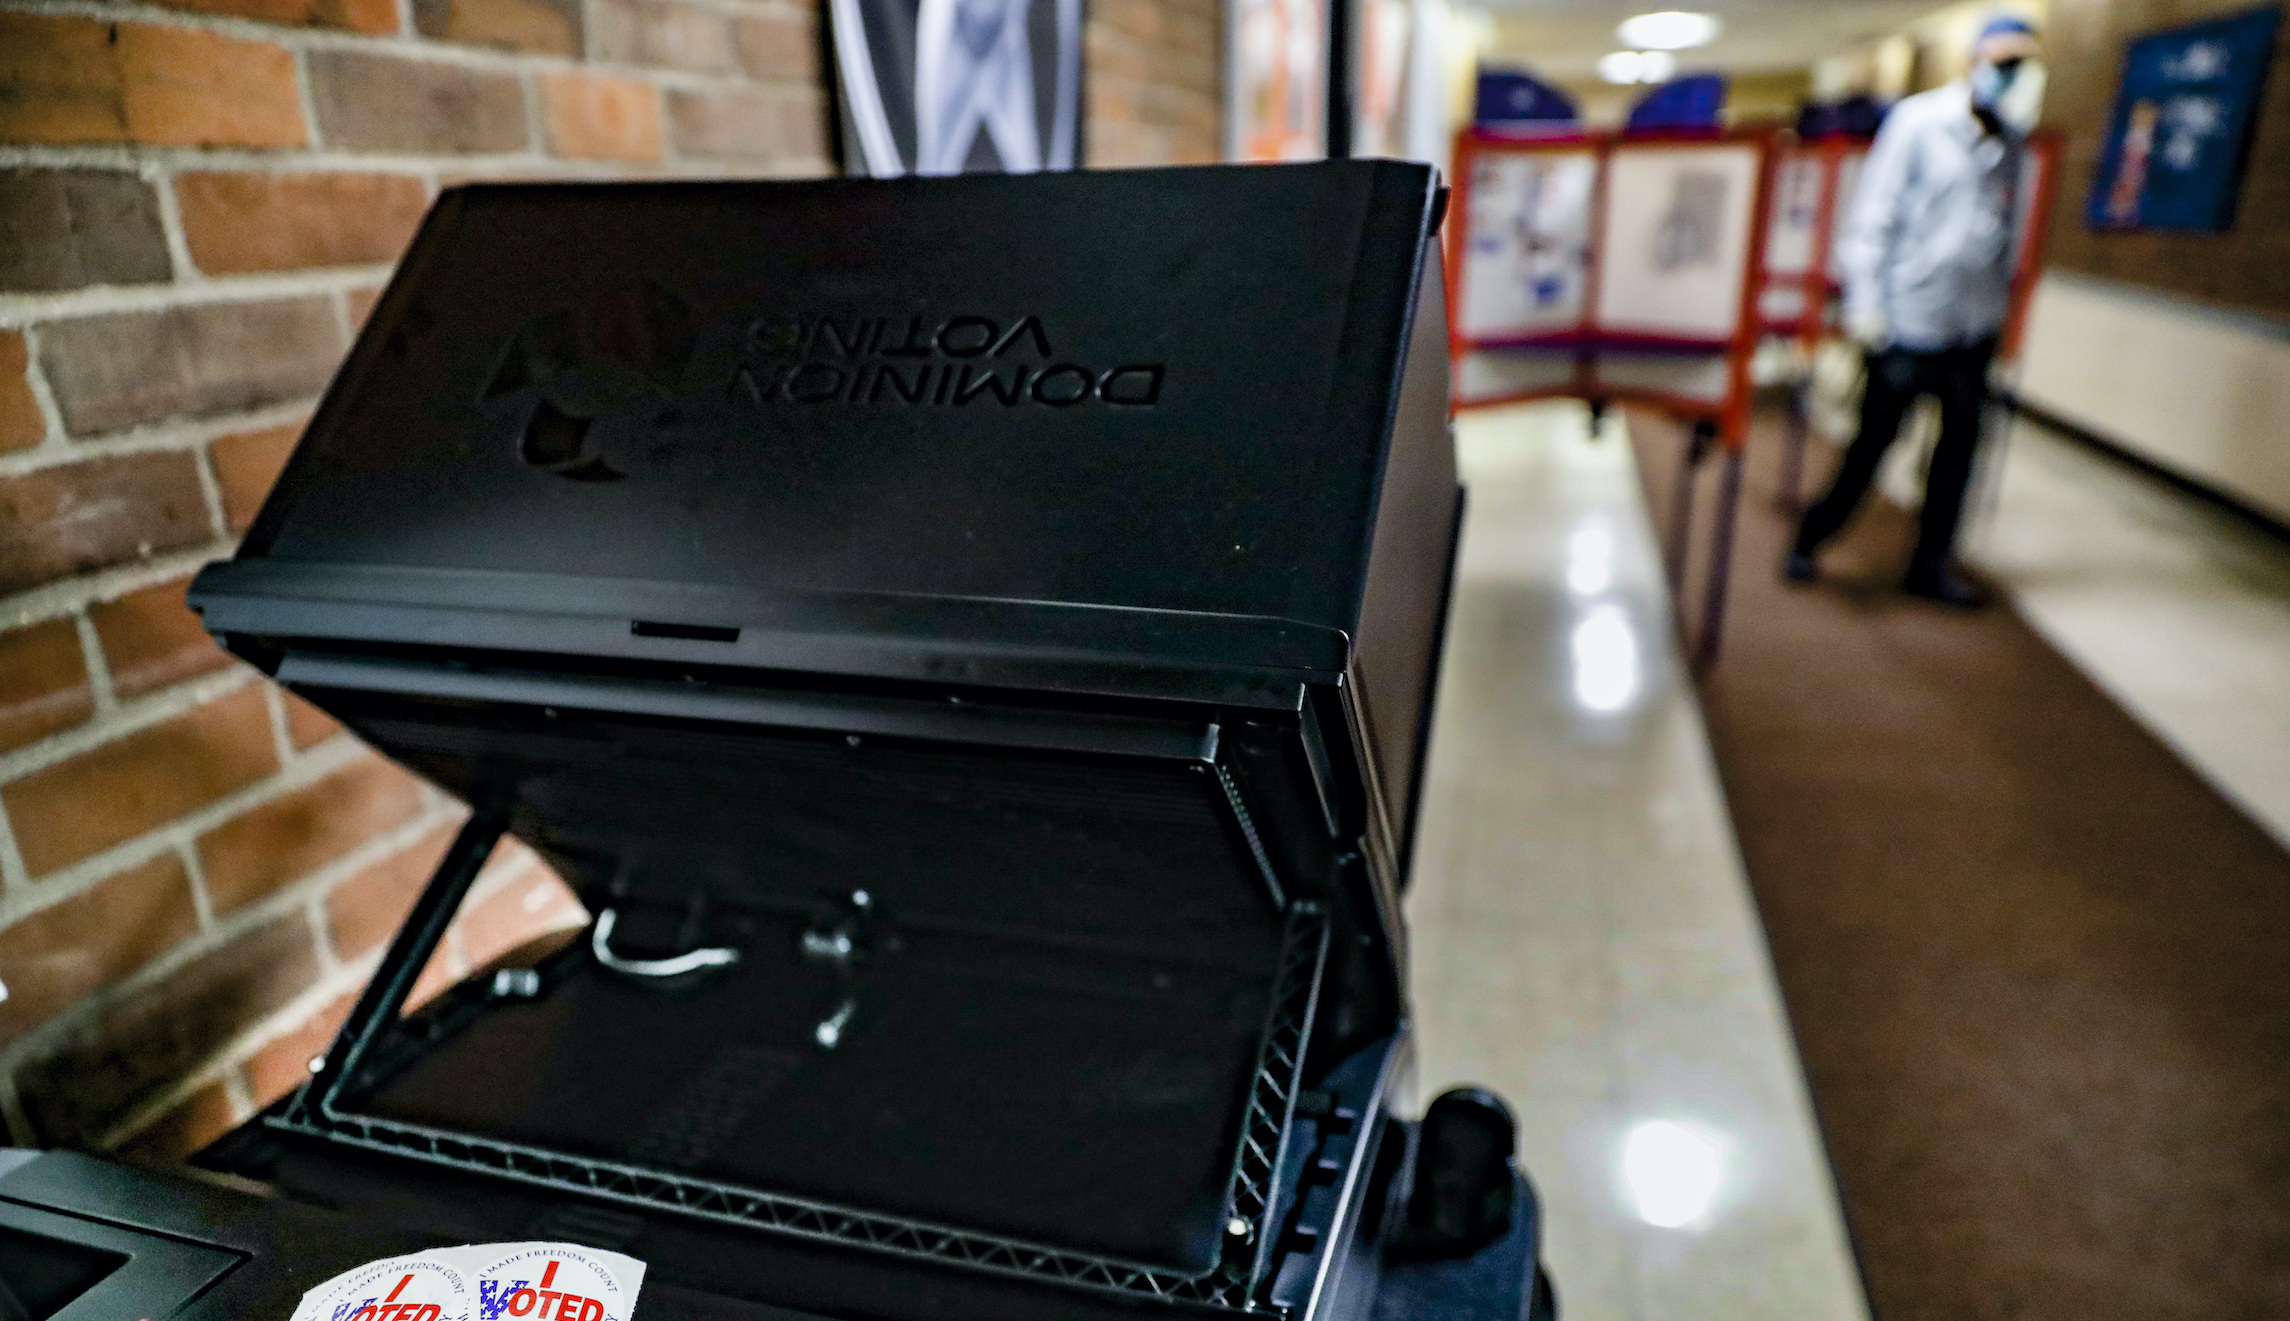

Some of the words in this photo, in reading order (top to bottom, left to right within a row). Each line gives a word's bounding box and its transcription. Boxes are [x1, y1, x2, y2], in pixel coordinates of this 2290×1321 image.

[749, 315, 1052, 358] VOTING
[728, 363, 1166, 407] DOMINION
[347, 1272, 384, 1296] MADE
[388, 1261, 445, 1275] FREEDOM
[443, 1269, 465, 1294] COUNT
[384, 1274, 415, 1303] I
[487, 1254, 523, 1274] MADE
[526, 1249, 586, 1264] FREEDOM
[588, 1261, 618, 1294] COUNT
[539, 1260, 560, 1289] I
[480, 1279, 604, 1321] VOTED
